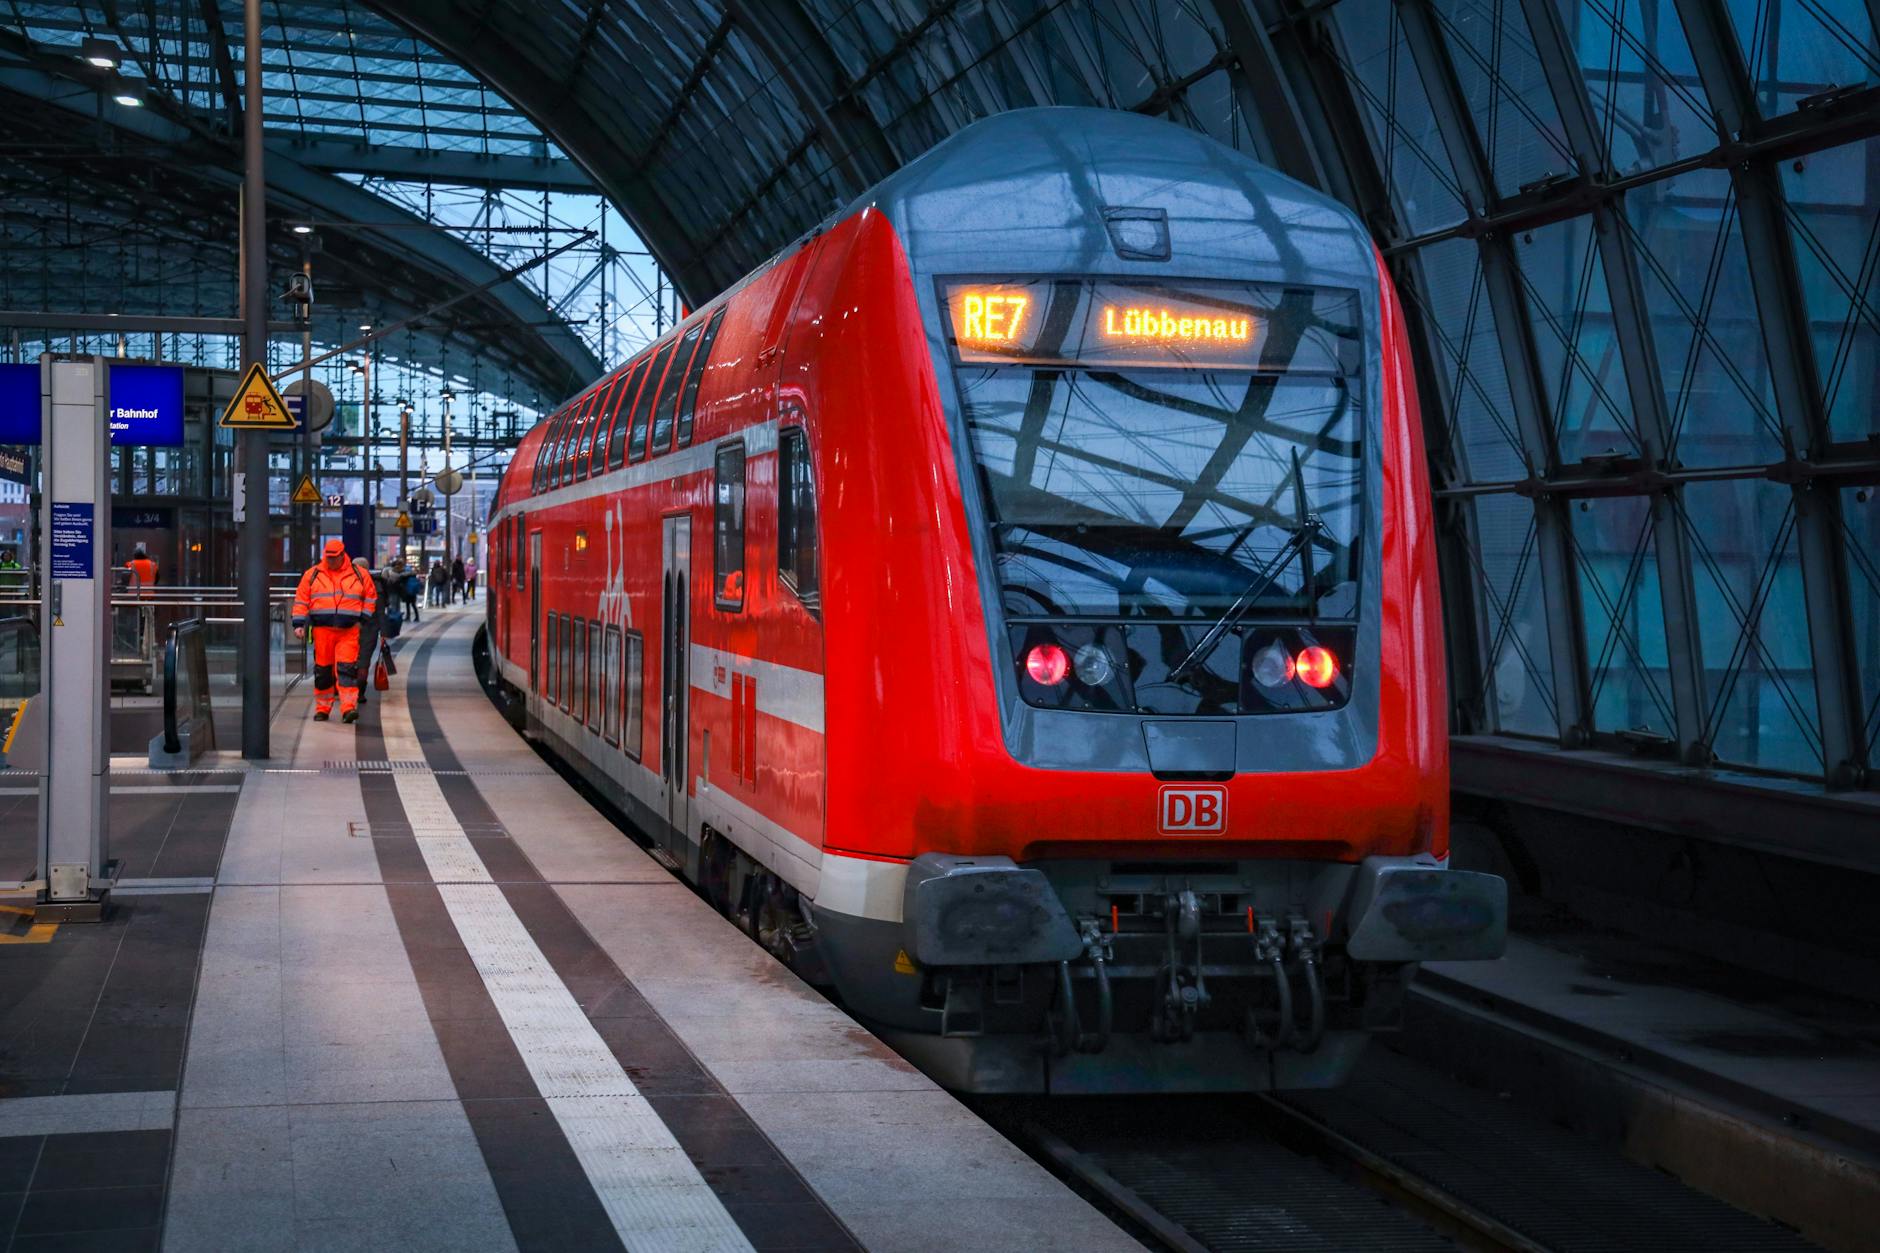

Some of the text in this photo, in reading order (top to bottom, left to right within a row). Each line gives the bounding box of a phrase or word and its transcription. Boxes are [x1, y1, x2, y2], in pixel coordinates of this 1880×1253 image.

[963, 294, 1248, 340] RE7 Lübbenau
[116, 407, 159, 419] Bahnhof
[110, 422, 129, 430] tation
[328, 495, 341, 506] 12
[1166, 793, 1219, 827] DB
